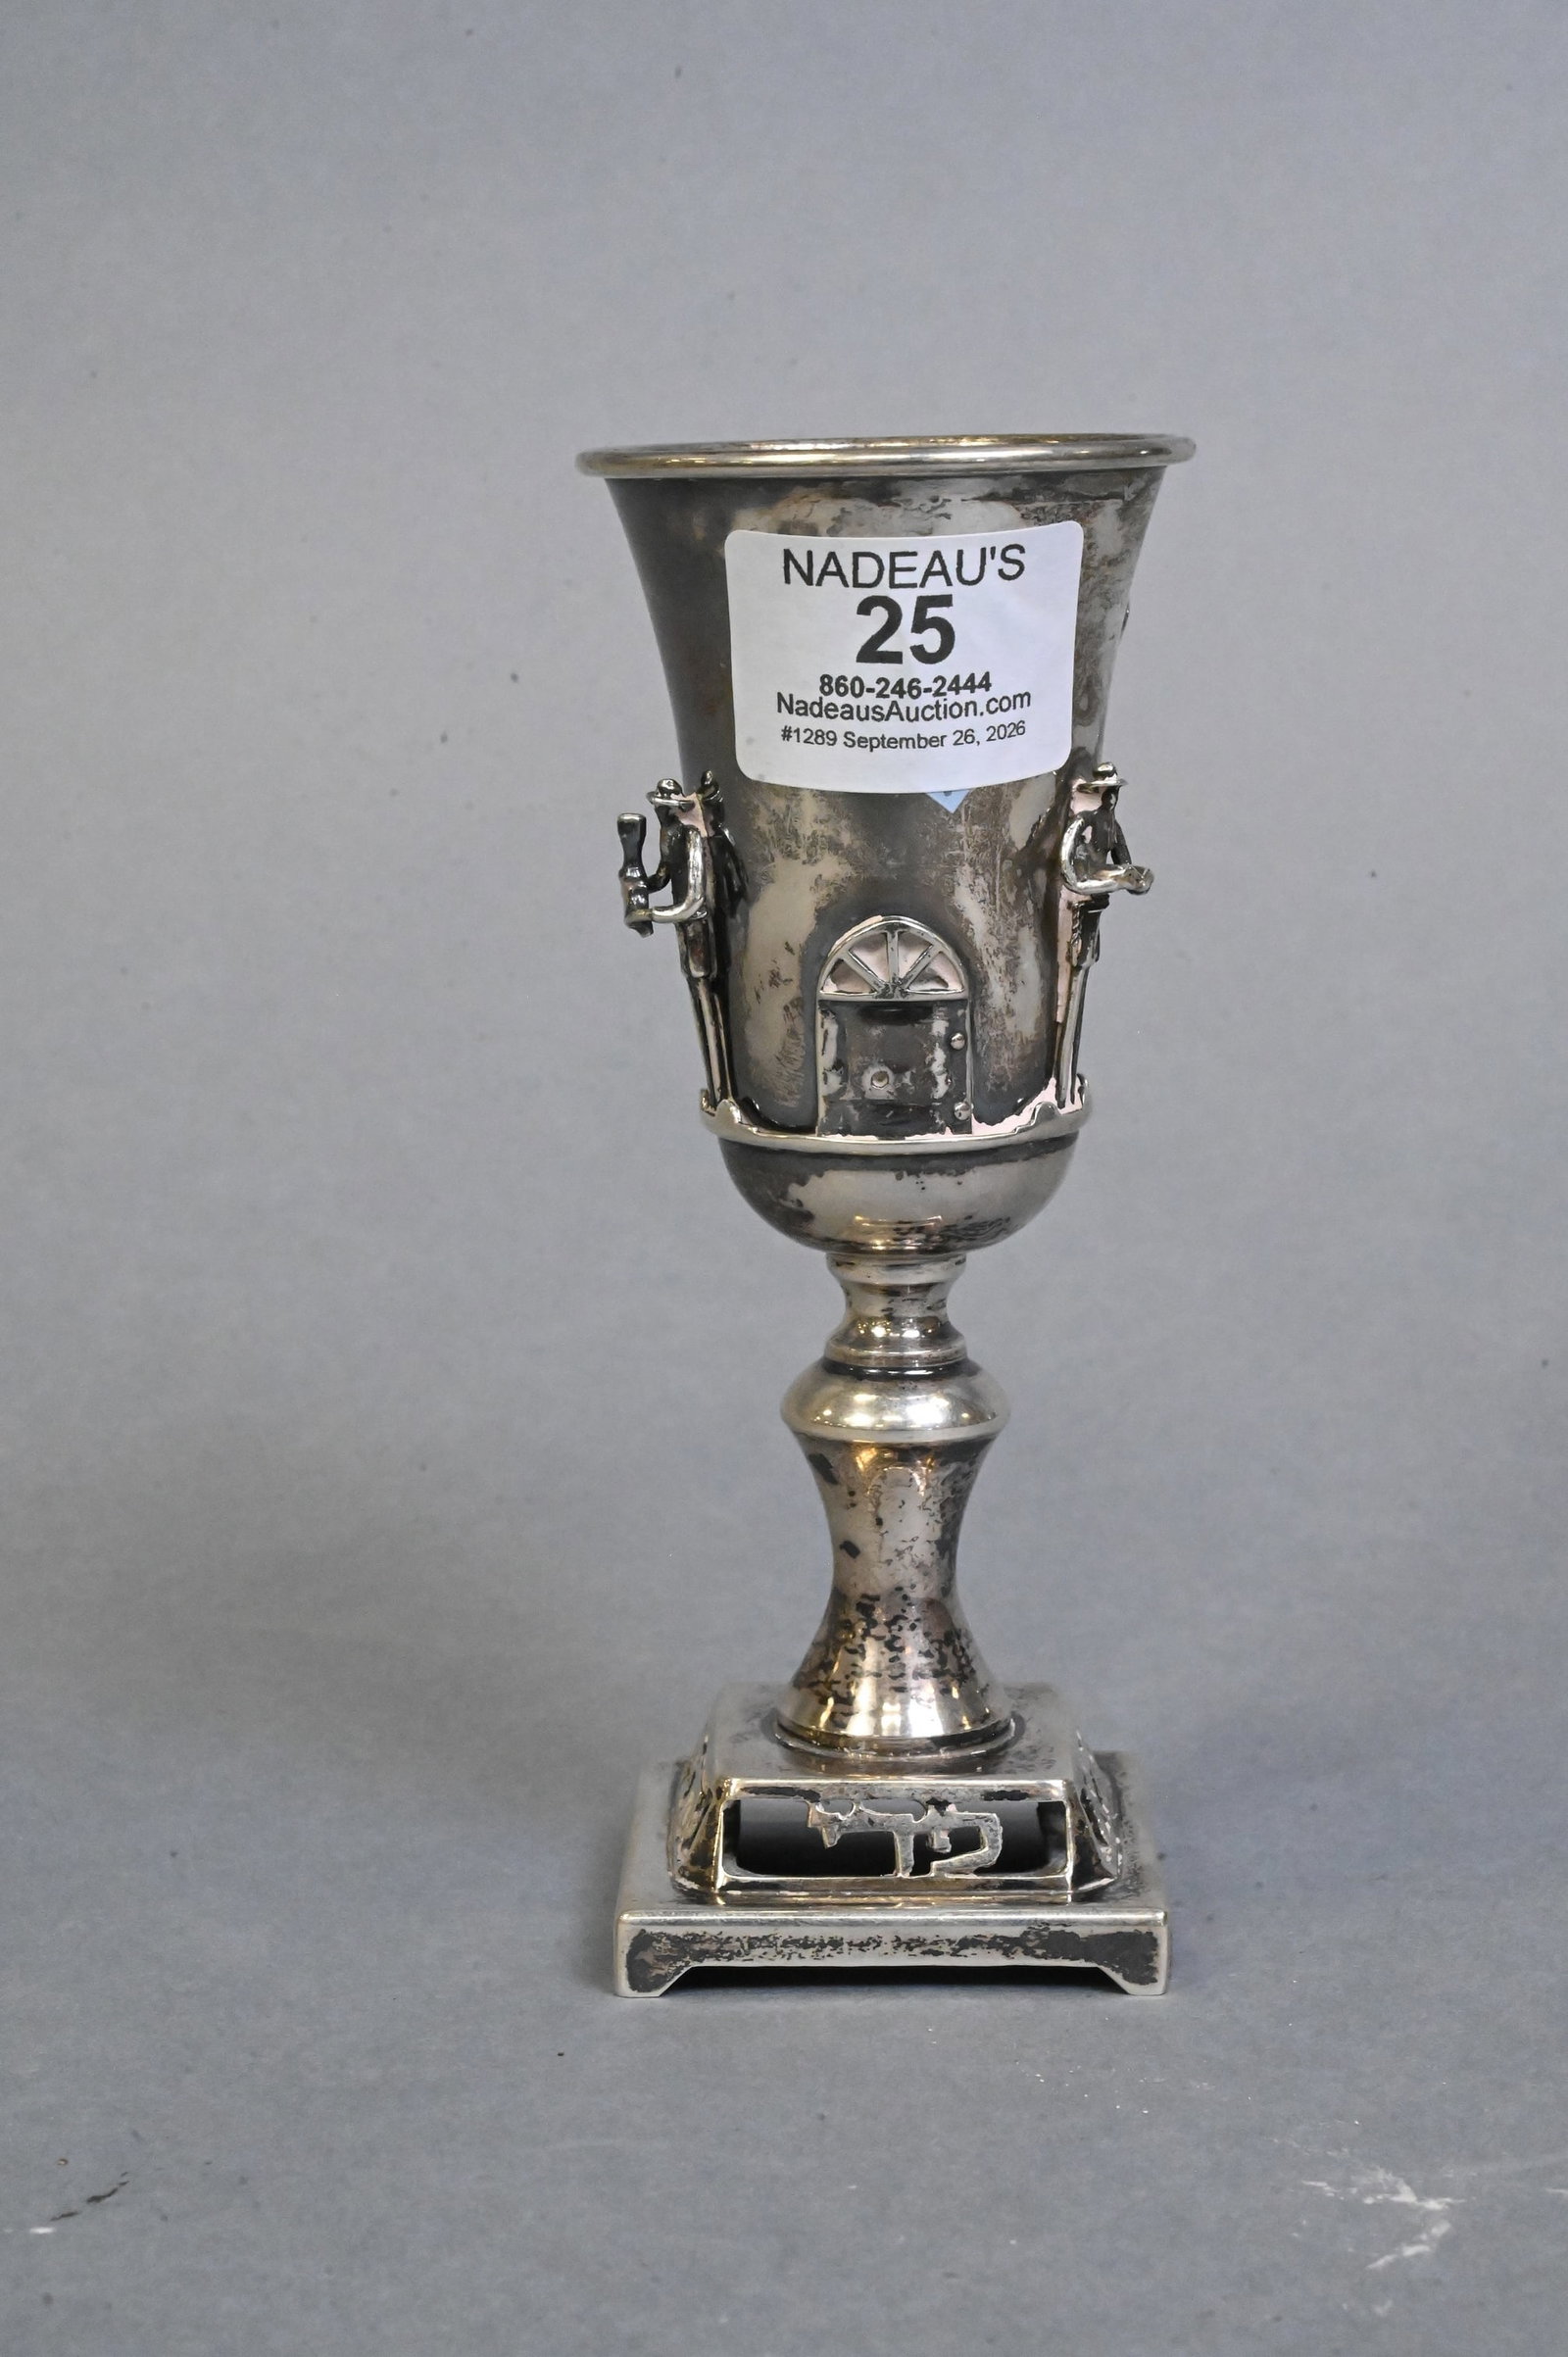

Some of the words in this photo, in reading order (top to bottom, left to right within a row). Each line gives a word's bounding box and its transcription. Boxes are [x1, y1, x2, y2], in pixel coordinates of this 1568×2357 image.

[783, 544, 1026, 590] NADEAU'S
[856, 593, 956, 665] 25
[818, 670, 993, 701] 860-246-2444
[776, 691, 1032, 723] NadeausAuction.com
[780, 724, 838, 747] #1289
[843, 729, 948, 753] September
[952, 728, 981, 746] 26,
[986, 719, 1027, 742] 2026
